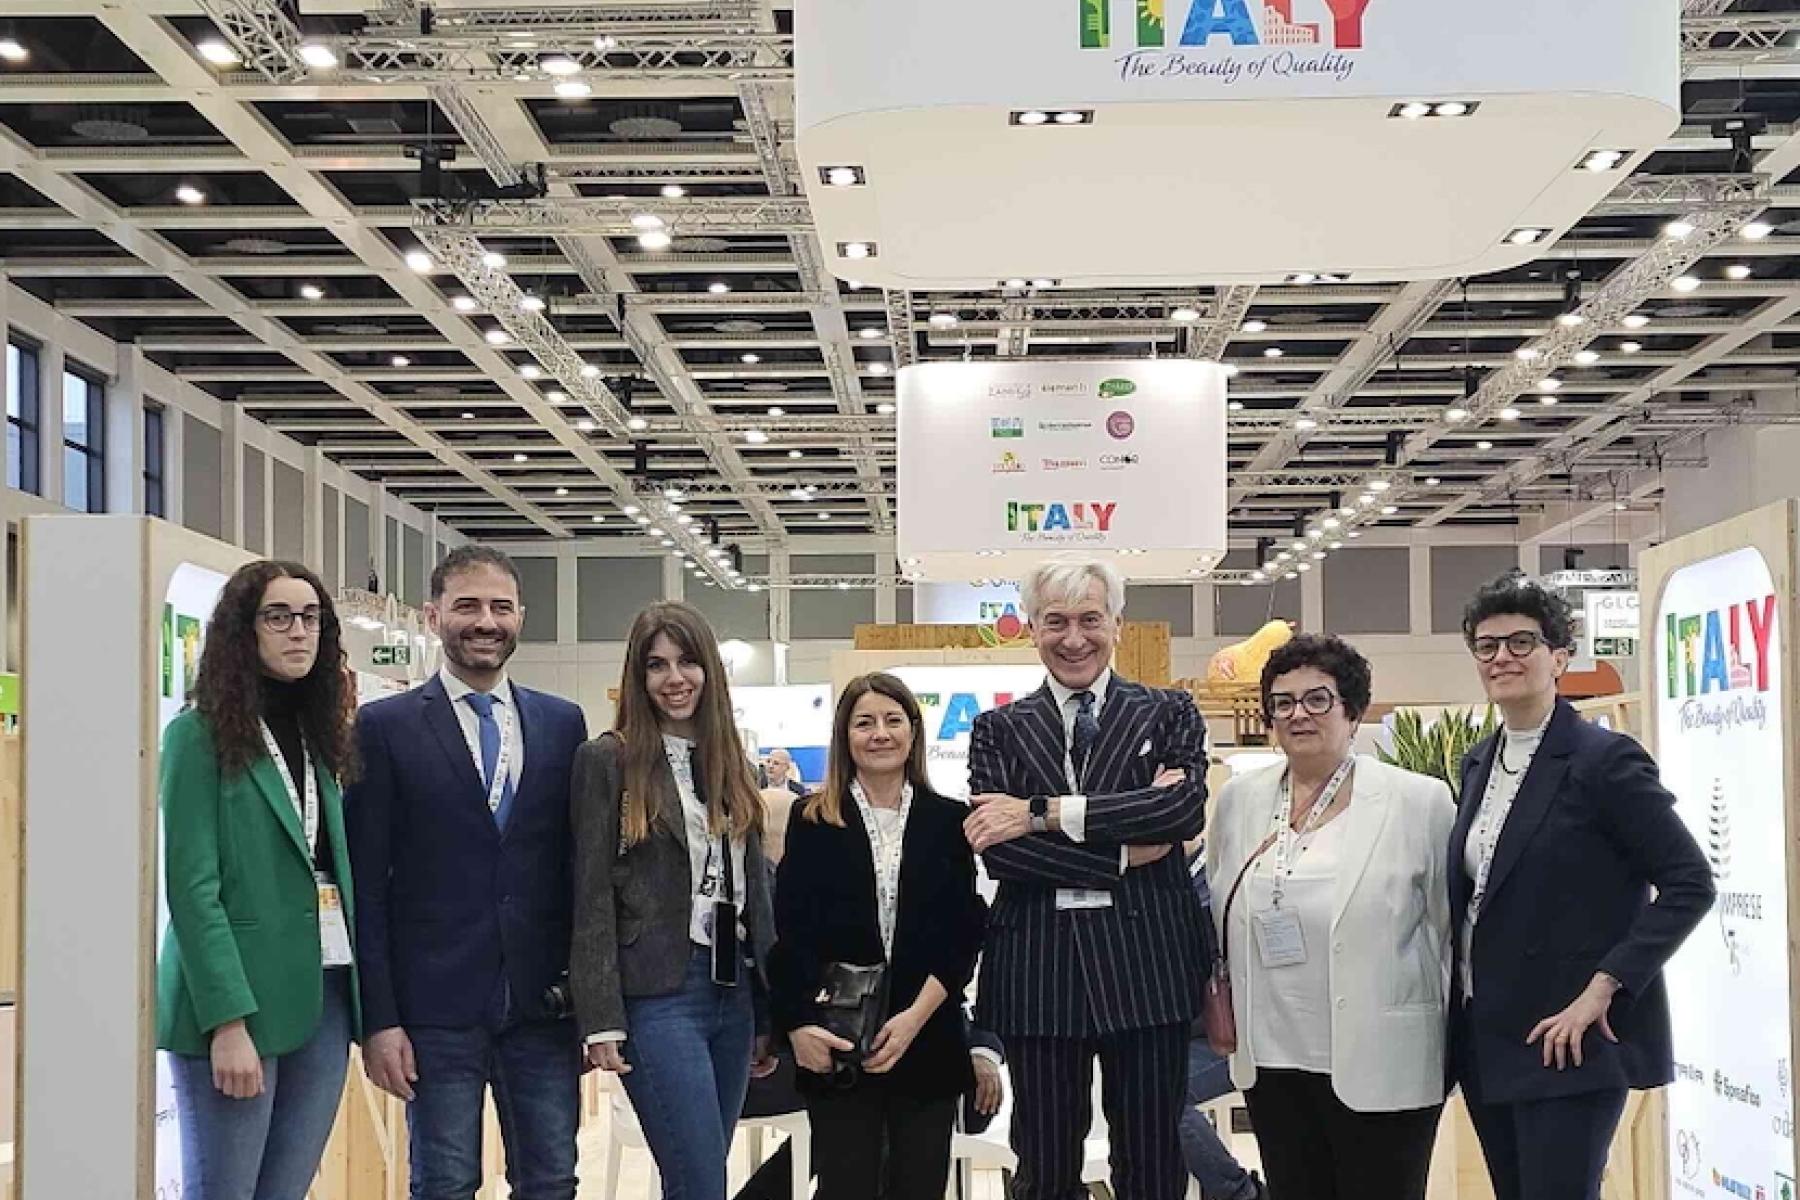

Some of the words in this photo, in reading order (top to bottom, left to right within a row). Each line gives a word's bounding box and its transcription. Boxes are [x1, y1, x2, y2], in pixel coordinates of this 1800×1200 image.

[1079, 0, 1371, 49] ITALY
[1115, 51, 1155, 82] The
[1160, 53, 1241, 83] Beauty
[1246, 54, 1272, 80] of
[1272, 51, 1355, 82] Quality
[1007, 501, 1117, 531] ITALY
[1667, 594, 1775, 698] ITALY
